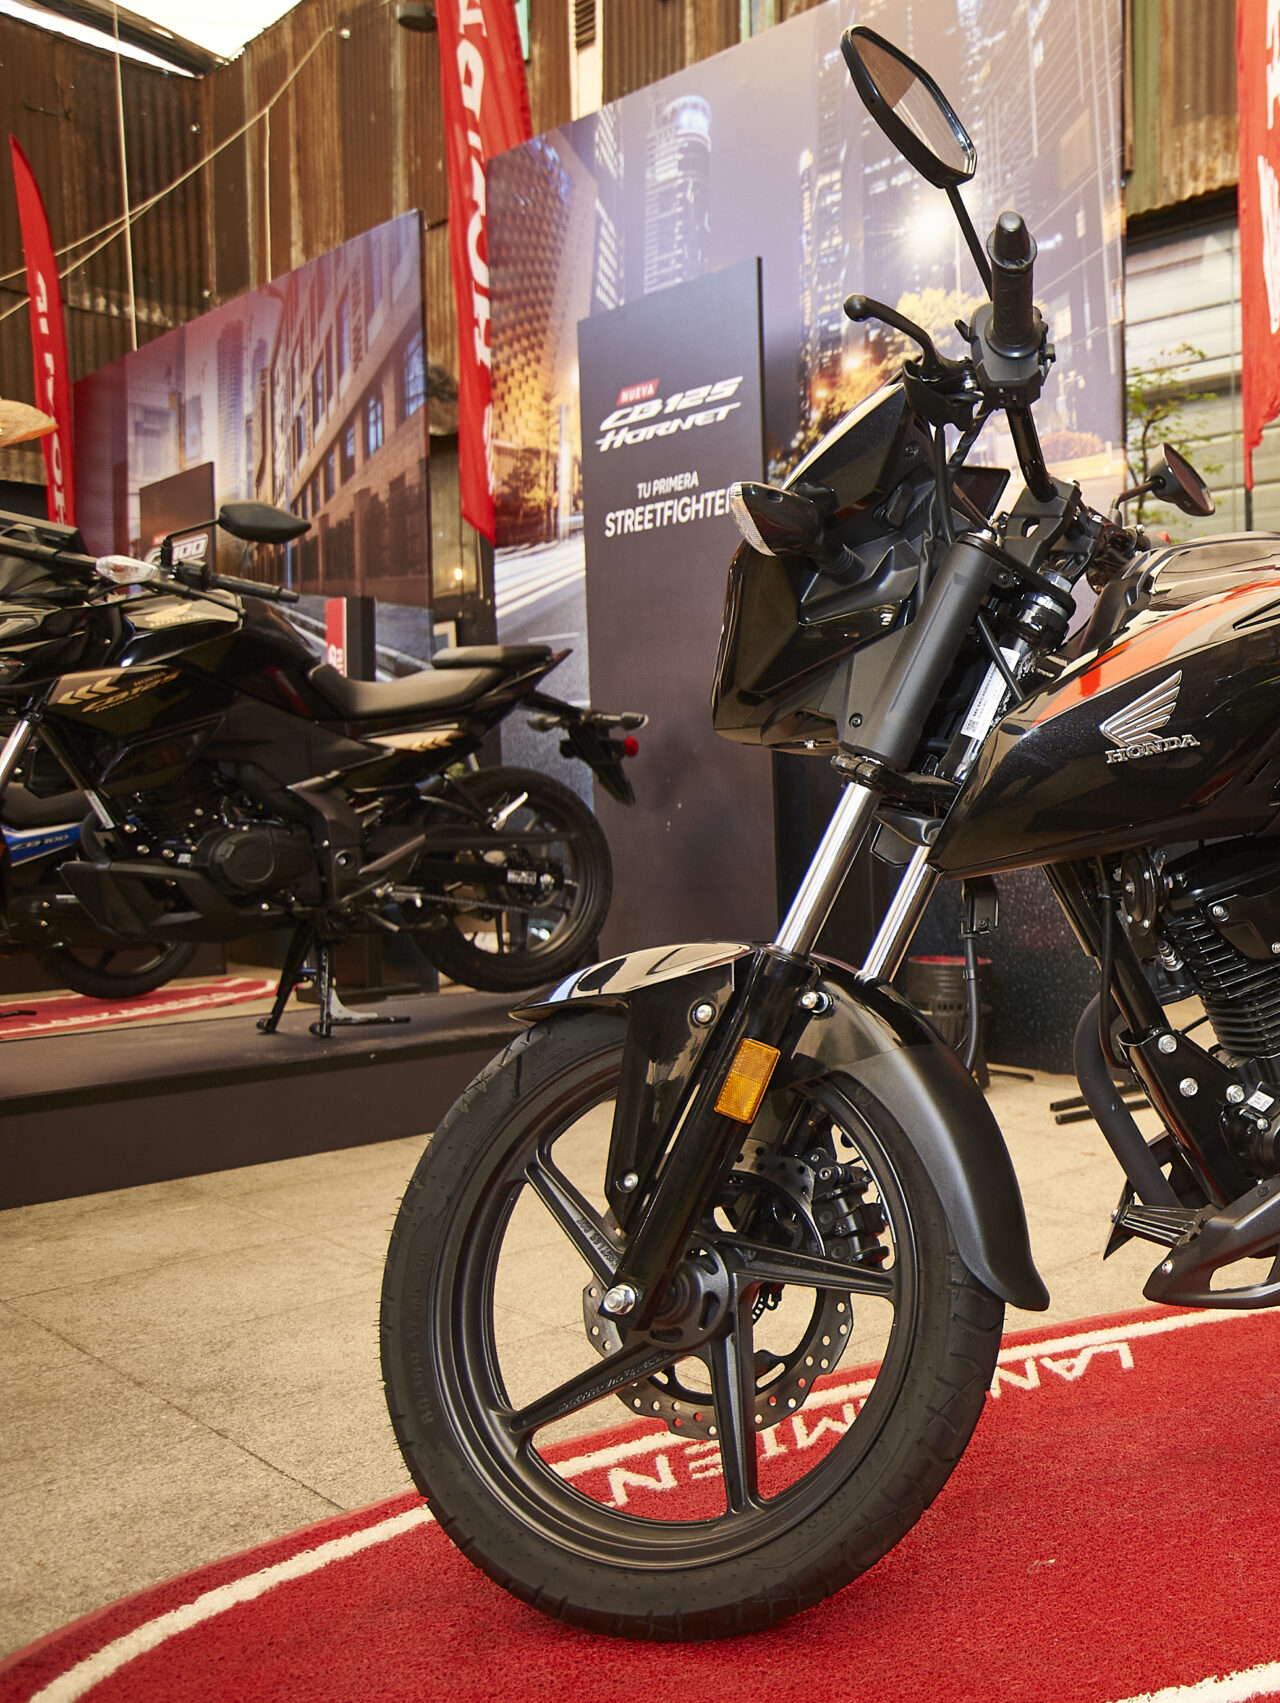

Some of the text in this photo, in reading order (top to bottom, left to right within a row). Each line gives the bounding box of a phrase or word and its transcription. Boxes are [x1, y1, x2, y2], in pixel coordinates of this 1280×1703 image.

[621, 383, 655, 404] NUEVA
[595, 402, 742, 453] HORNET
[637, 471, 699, 500] TU PRIMERA
[1105, 733, 1201, 764] HONDA
